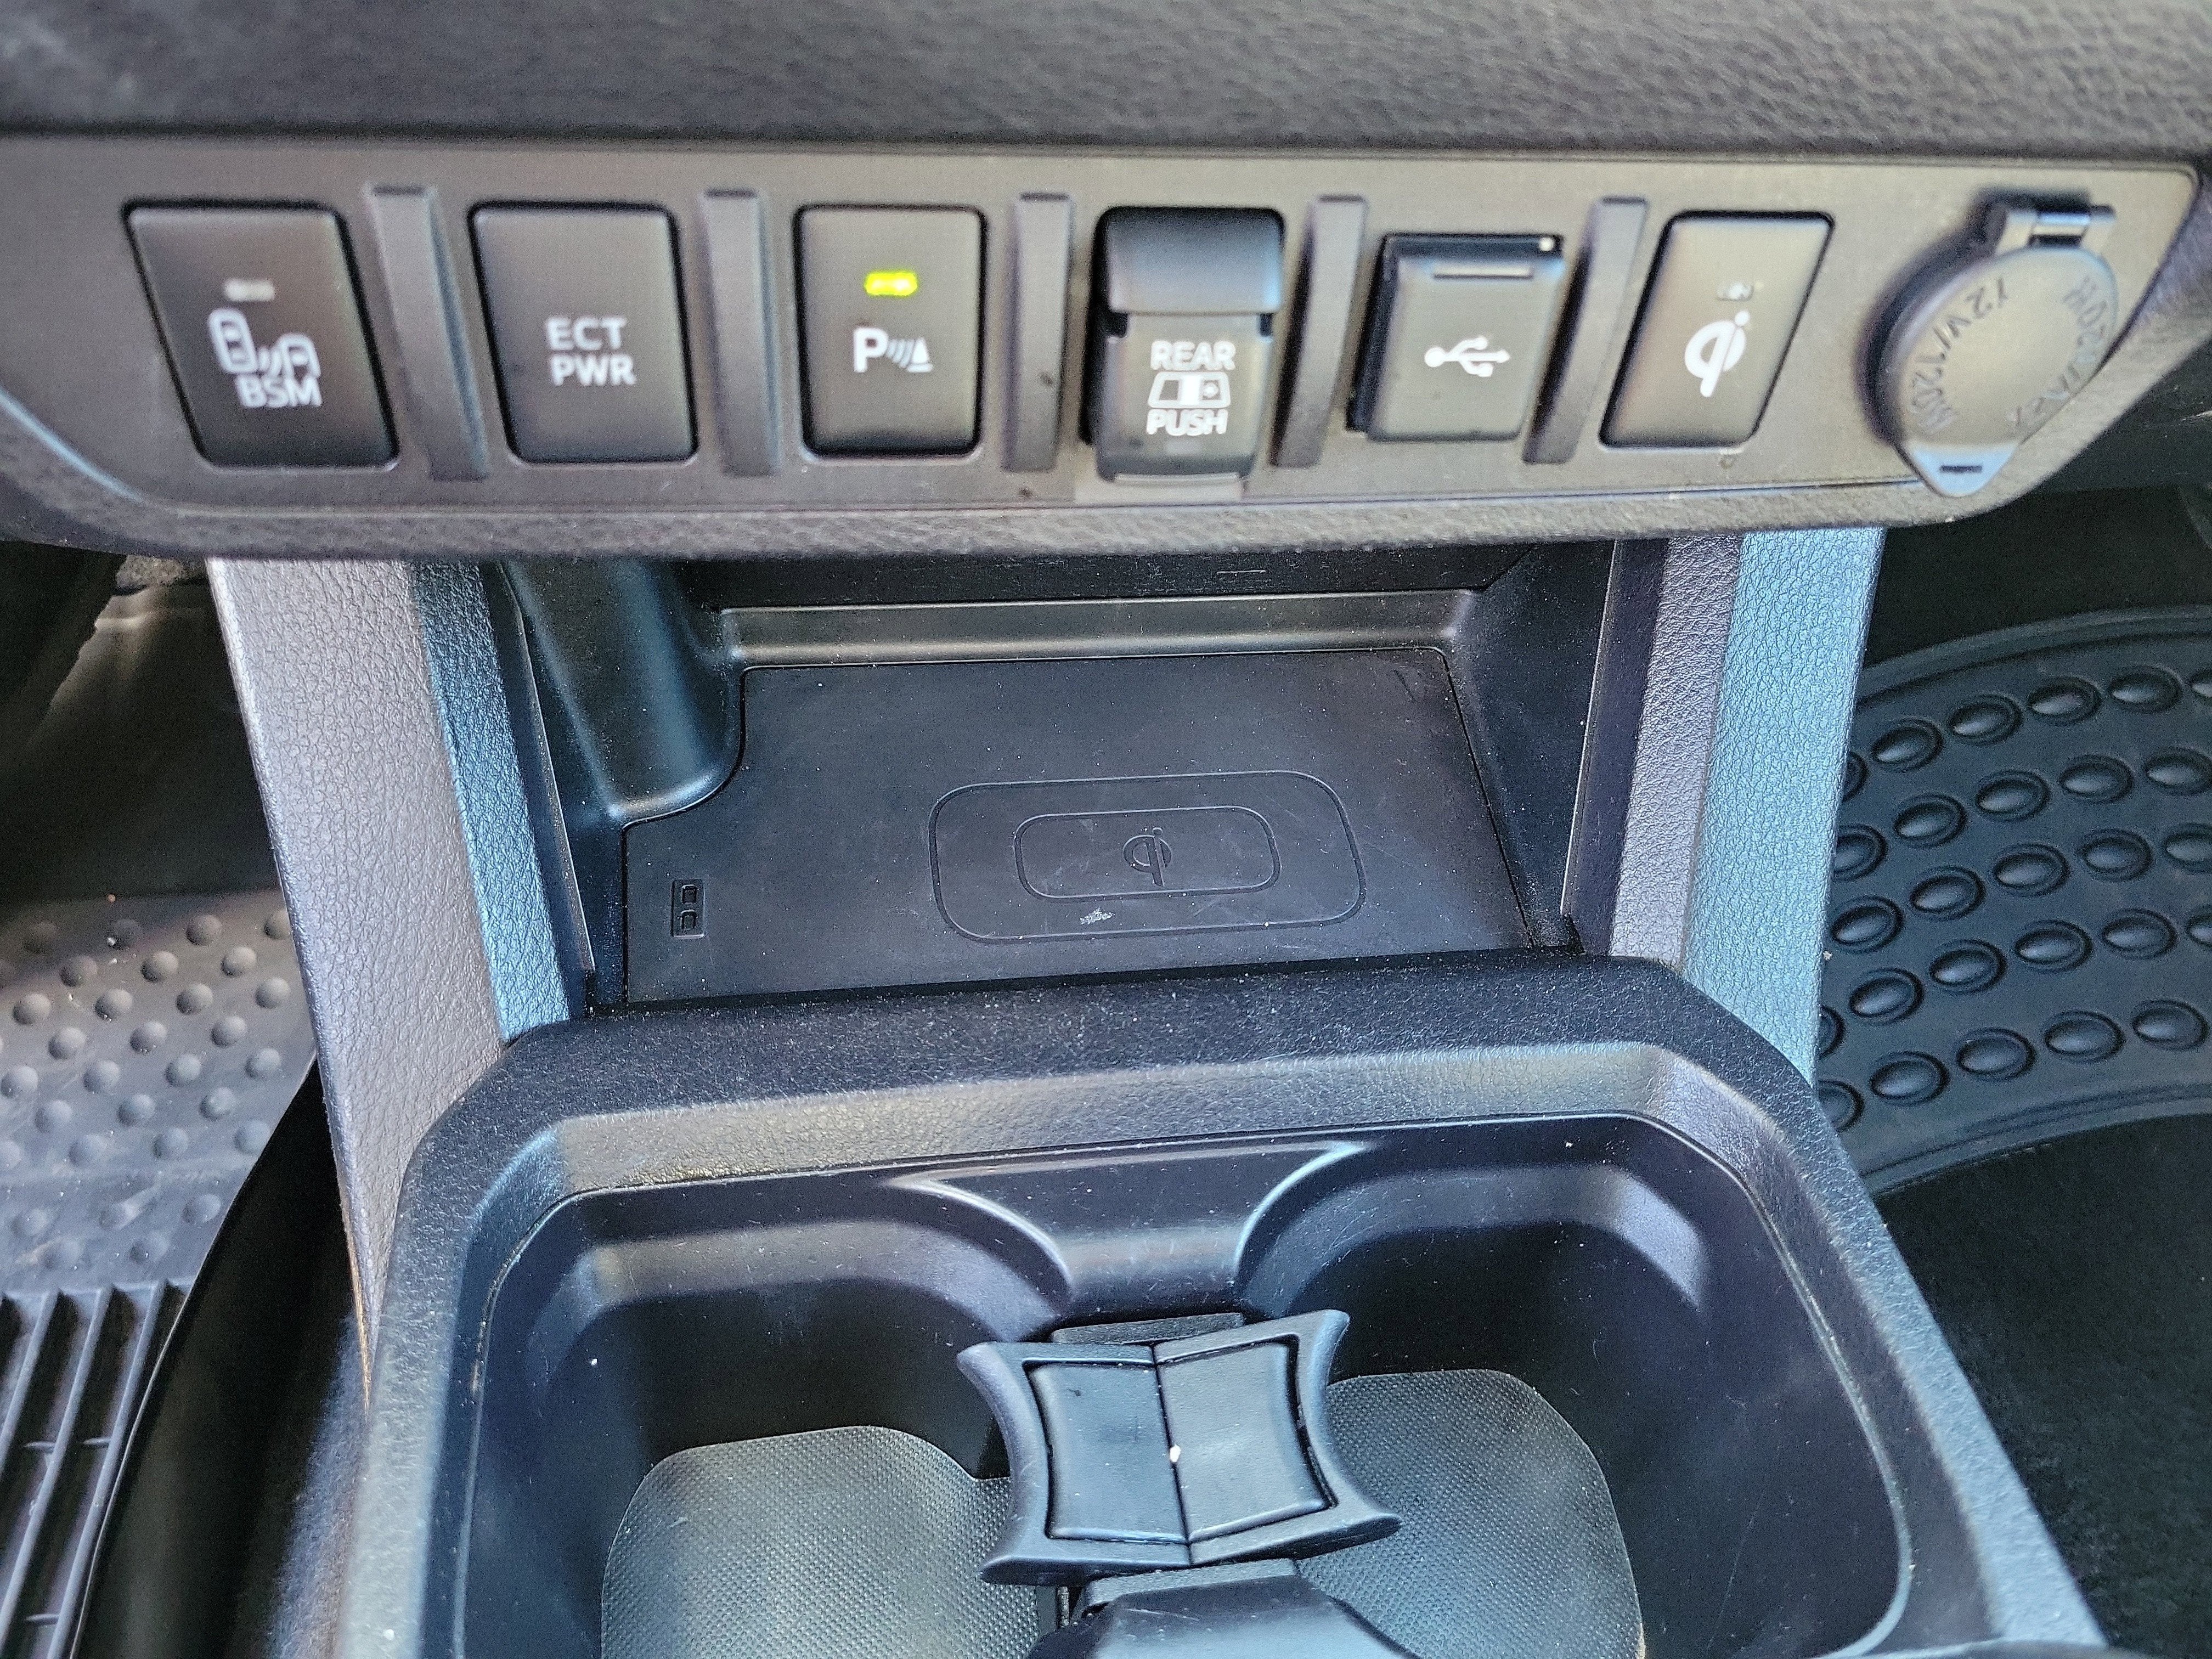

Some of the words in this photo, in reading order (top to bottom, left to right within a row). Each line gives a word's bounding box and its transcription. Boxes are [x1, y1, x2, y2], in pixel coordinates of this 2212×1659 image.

[547, 315, 628, 351] ECT
[550, 354, 636, 386] PWR
[1150, 340, 1235, 371] REAR
[235, 375, 323, 408] BSM
[1146, 409, 1228, 436] PUSH
